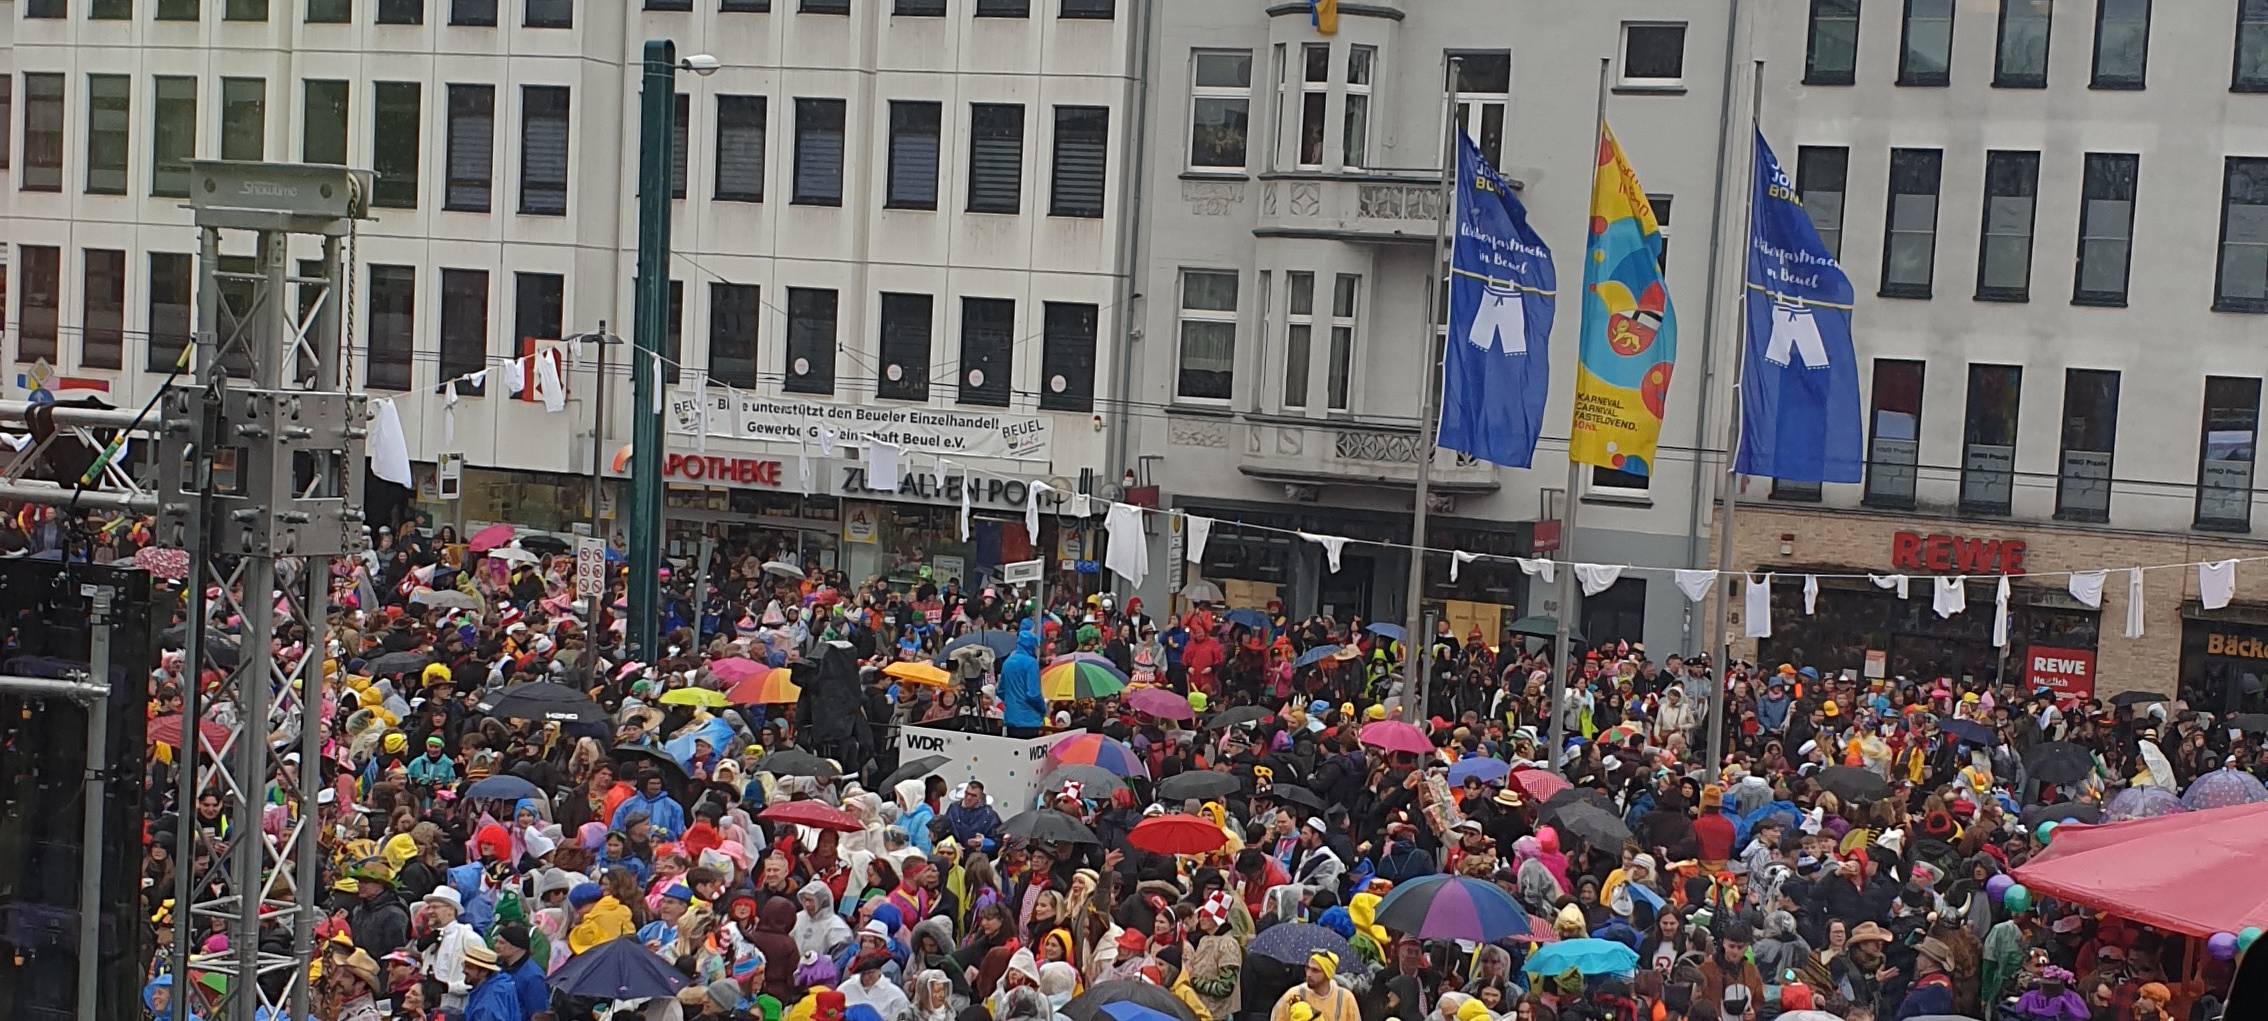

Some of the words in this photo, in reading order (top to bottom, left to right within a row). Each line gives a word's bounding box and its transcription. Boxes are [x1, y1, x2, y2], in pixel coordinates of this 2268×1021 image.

[1479, 250, 1490, 263] in
[1494, 252, 1528, 274] Beuel
[1780, 266, 1819, 289] Beuel
[718, 398, 749, 411] Bie
[828, 406, 852, 419] den
[856, 409, 906, 423] Beueler
[910, 412, 999, 430] Einzelhandel!
[1002, 418, 1044, 439] BEUEL
[903, 433, 940, 446] Beuel
[944, 436, 965, 449] e.V.
[899, 471, 981, 503] ALTEN
[1891, 531, 2027, 575] REWE
[2034, 656, 2086, 676] REWE
[907, 734, 944, 752] WDR
[1030, 744, 1048, 761] WDR
